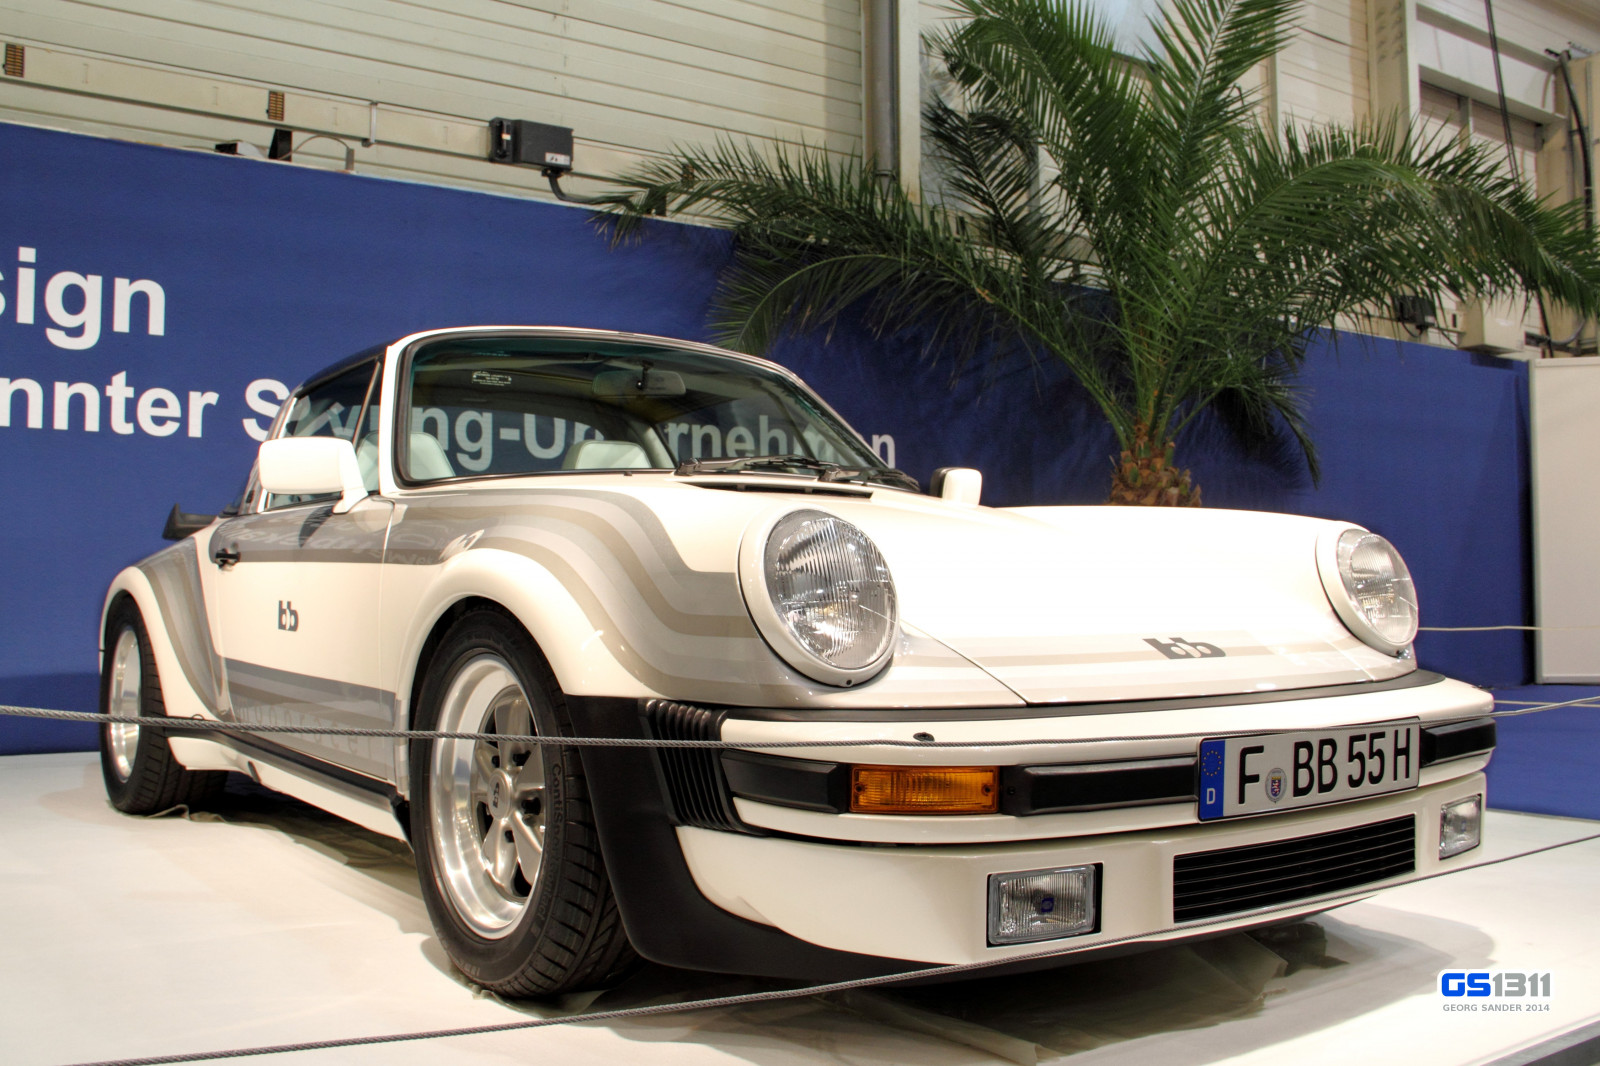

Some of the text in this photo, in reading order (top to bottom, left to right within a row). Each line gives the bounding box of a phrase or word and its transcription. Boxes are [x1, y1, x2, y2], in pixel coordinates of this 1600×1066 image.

[0, 246, 166, 350] ign
[1206, 787, 1216, 805] D
[1238, 745, 1265, 804] F
[1293, 738, 1338, 797] BB
